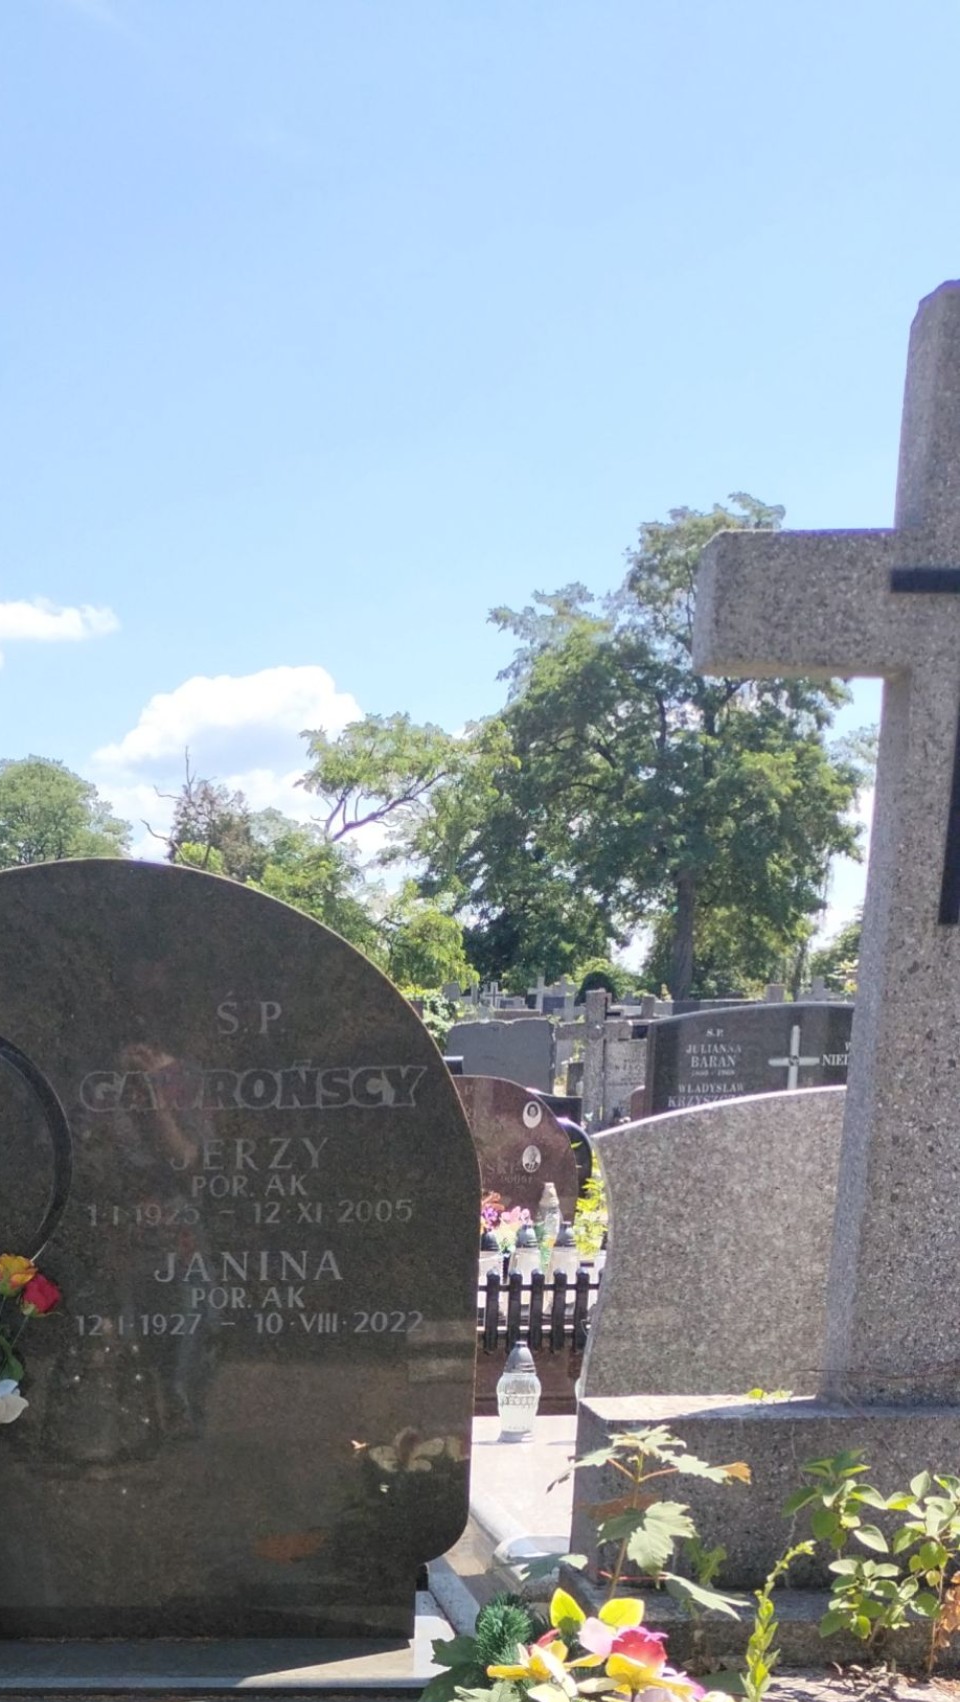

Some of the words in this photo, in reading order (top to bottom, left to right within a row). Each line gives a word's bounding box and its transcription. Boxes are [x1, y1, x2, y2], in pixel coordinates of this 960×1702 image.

[264, 1174, 308, 1197] AK
[154, 1250, 344, 1283] JANINA
[191, 1286, 252, 1310] POR.
[262, 1286, 306, 1309] AK
